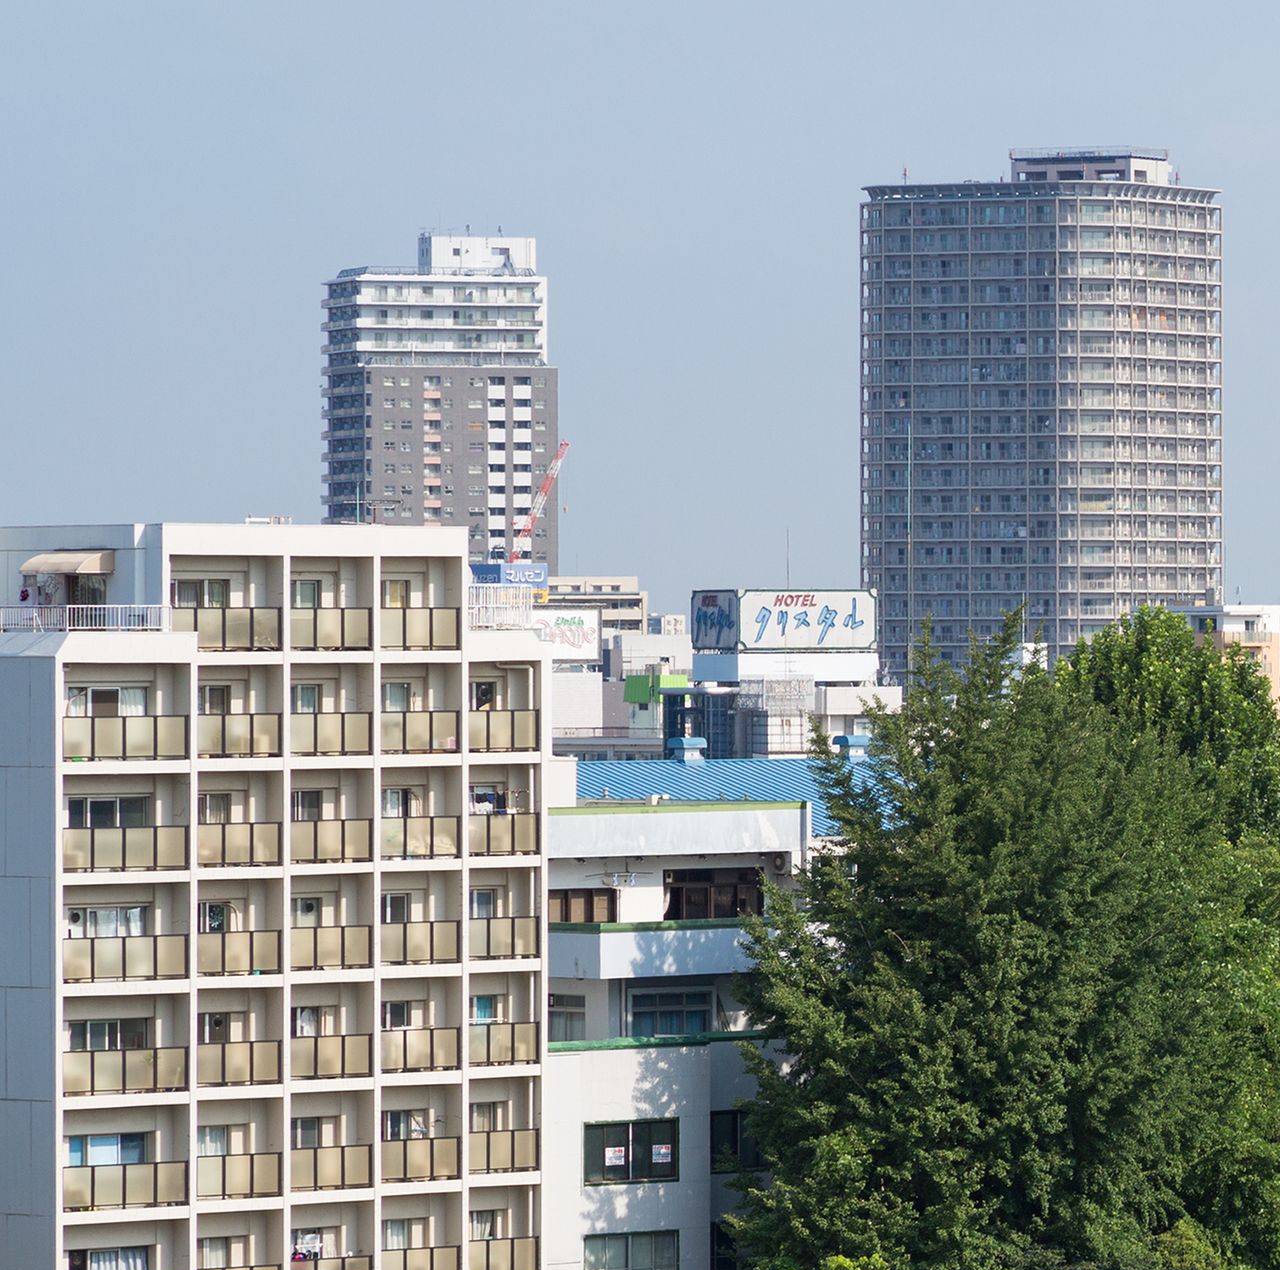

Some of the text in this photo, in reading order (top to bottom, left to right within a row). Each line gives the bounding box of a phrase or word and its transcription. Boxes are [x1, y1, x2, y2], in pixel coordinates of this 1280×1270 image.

[505, 569, 545, 582] マルセン
[773, 593, 818, 608] HOTEL
[754, 597, 865, 646] クリスタル
